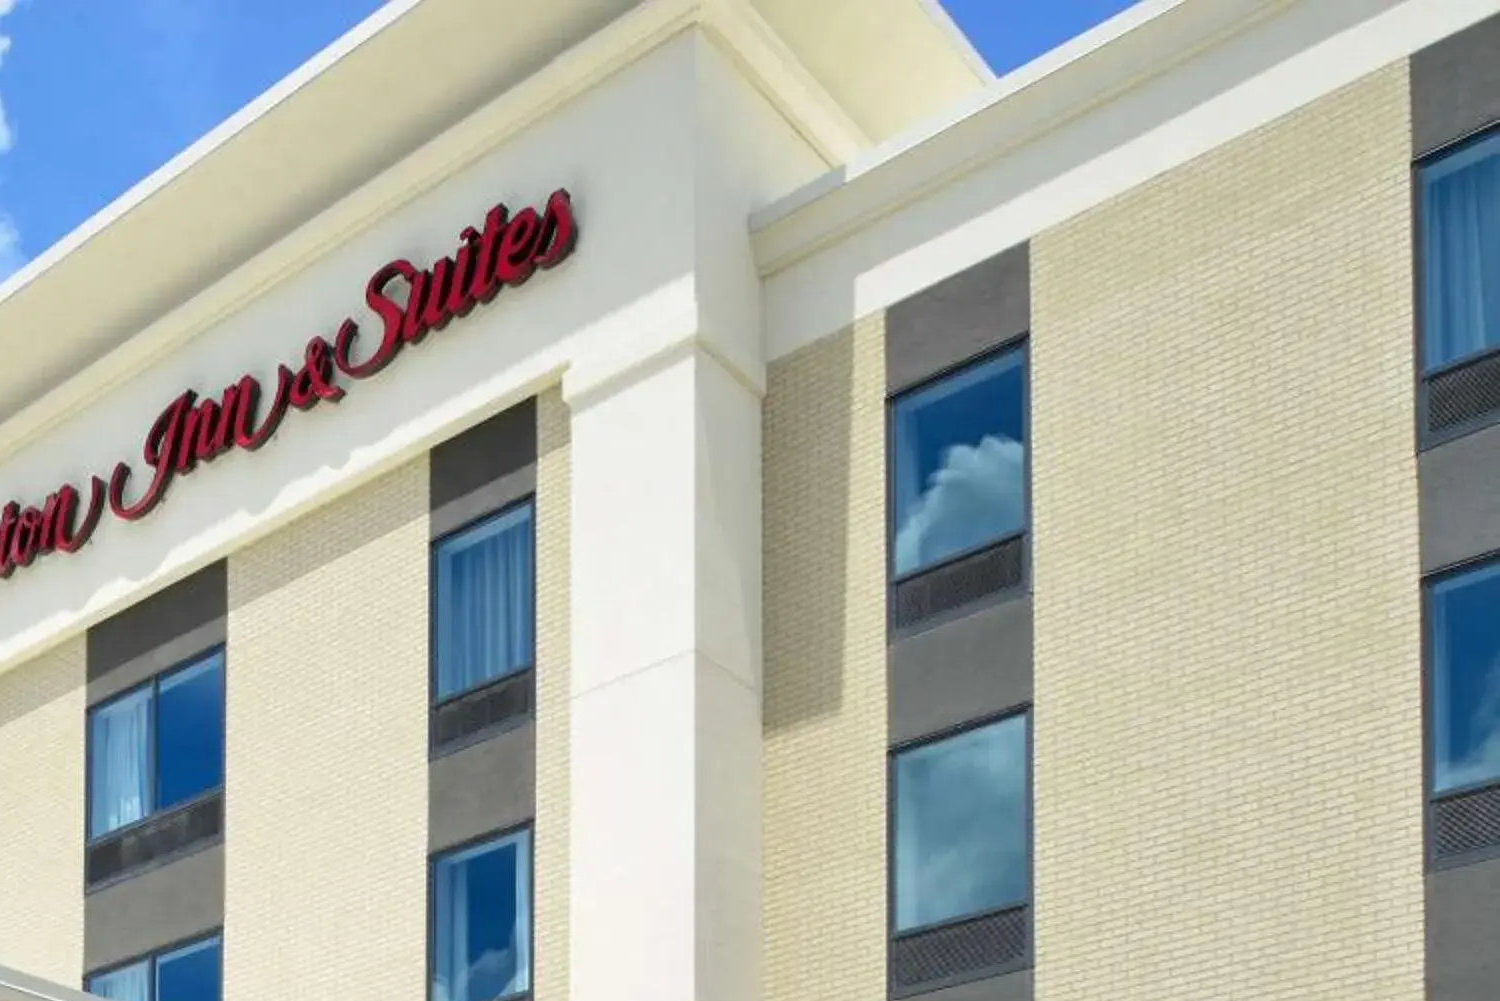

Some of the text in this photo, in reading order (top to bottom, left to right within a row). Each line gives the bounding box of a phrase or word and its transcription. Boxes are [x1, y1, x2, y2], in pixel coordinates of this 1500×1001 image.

[108, 363, 295, 522] Inn
[289, 335, 347, 411] &
[334, 187, 579, 380] Suites
